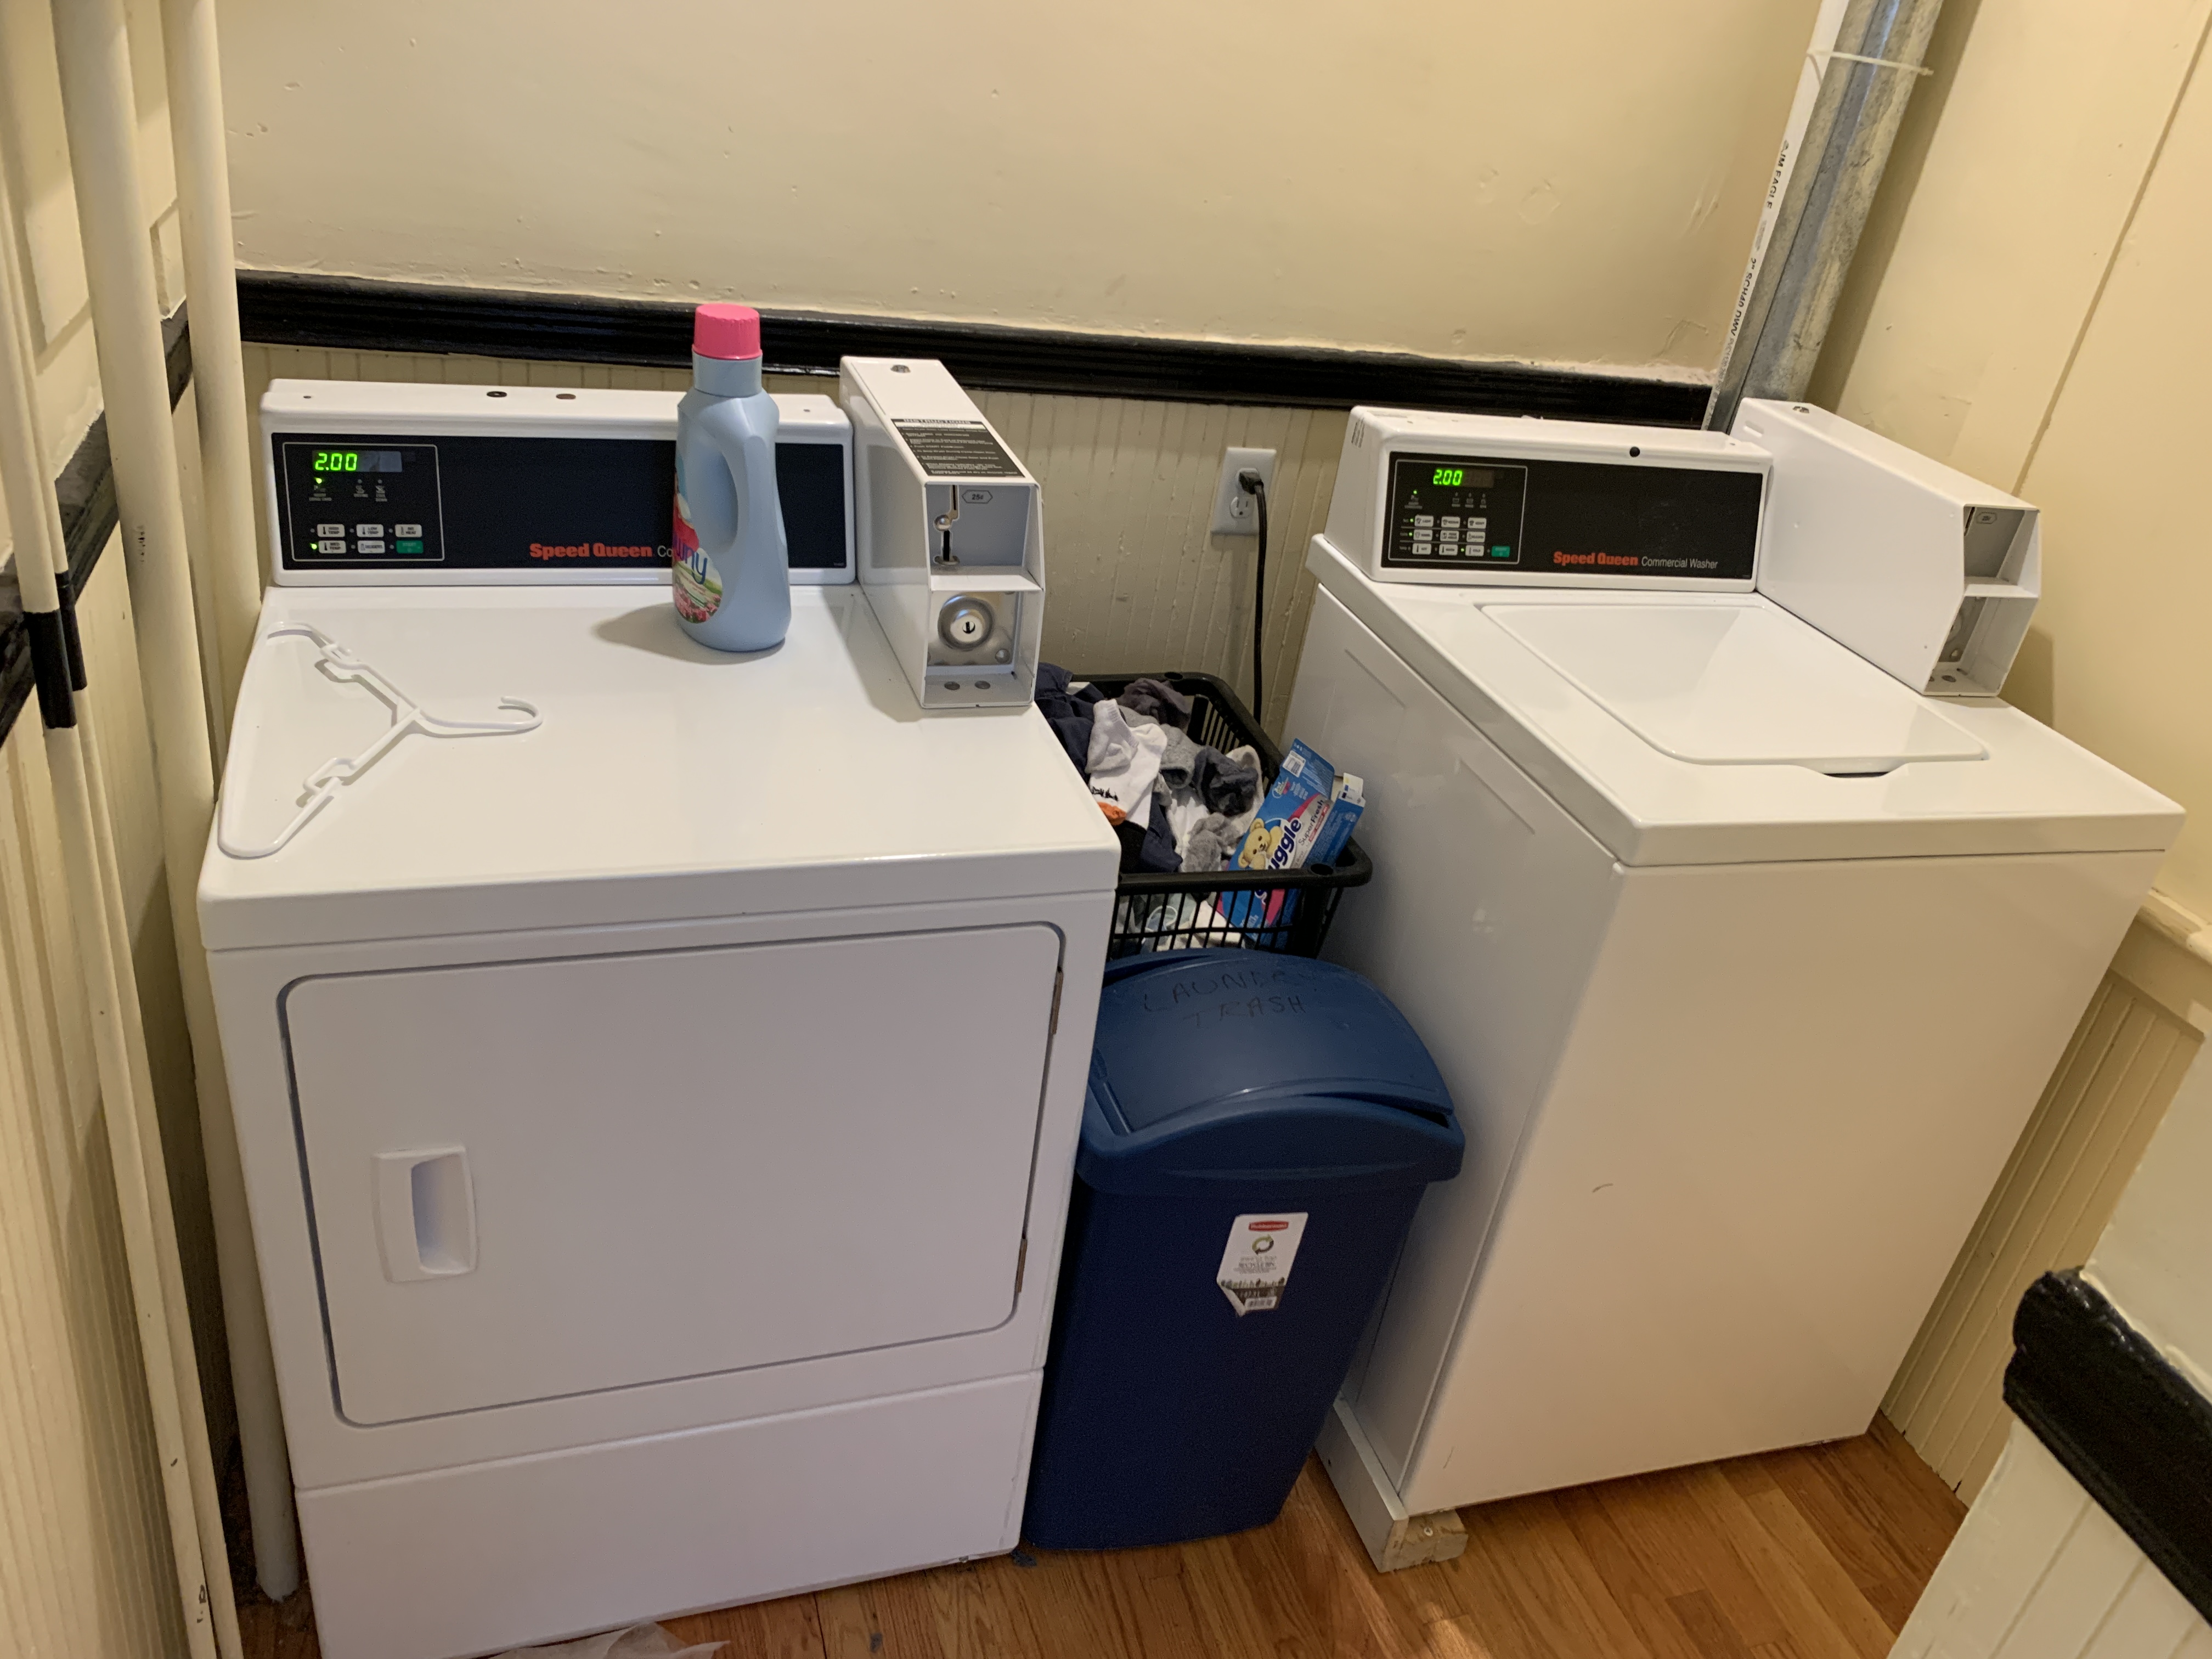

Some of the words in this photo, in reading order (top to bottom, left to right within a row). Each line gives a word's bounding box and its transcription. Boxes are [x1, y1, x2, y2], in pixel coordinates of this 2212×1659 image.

[315, 453, 357, 471] 2.00
[1433, 469, 1463, 486] 2.00
[529, 543, 590, 560] Speed
[592, 542, 652, 557] Queen
[1553, 551, 1595, 566] Speed
[1597, 552, 1639, 566] Queen
[1641, 556, 1688, 568] Commercial
[1690, 558, 1718, 569] Washer
